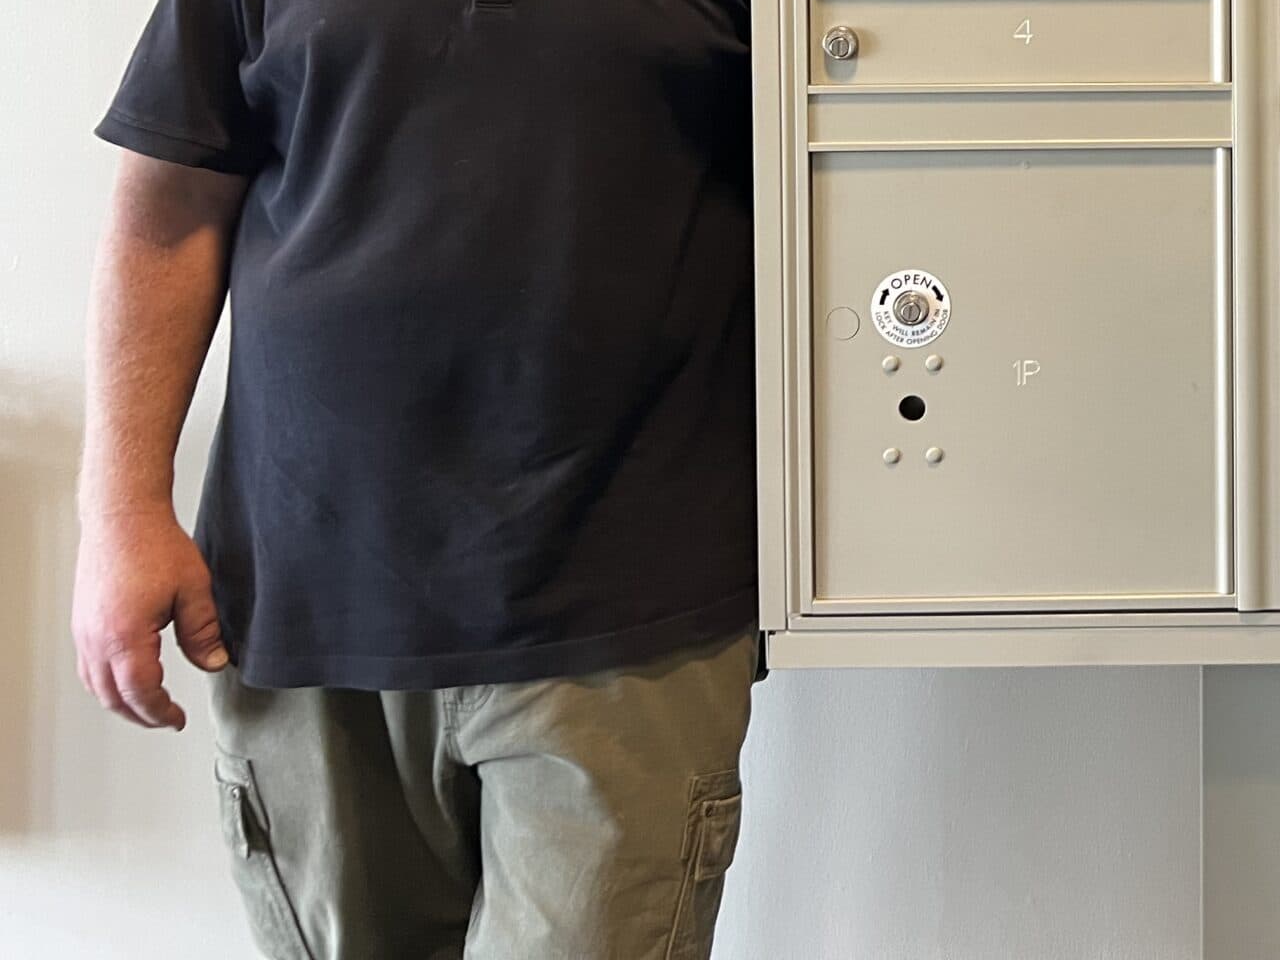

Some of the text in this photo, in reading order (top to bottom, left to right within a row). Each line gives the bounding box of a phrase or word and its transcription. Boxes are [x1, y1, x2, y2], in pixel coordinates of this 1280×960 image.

[1012, 18, 1034, 46] 4
[891, 273, 932, 289] OPEN
[875, 309, 948, 345] LOCK AFTER OPENING DOOR
[883, 310, 893, 324] KEY
[892, 324, 909, 337] WILL
[911, 318, 937, 337] REMAIN
[1013, 359, 1041, 387] 1P
